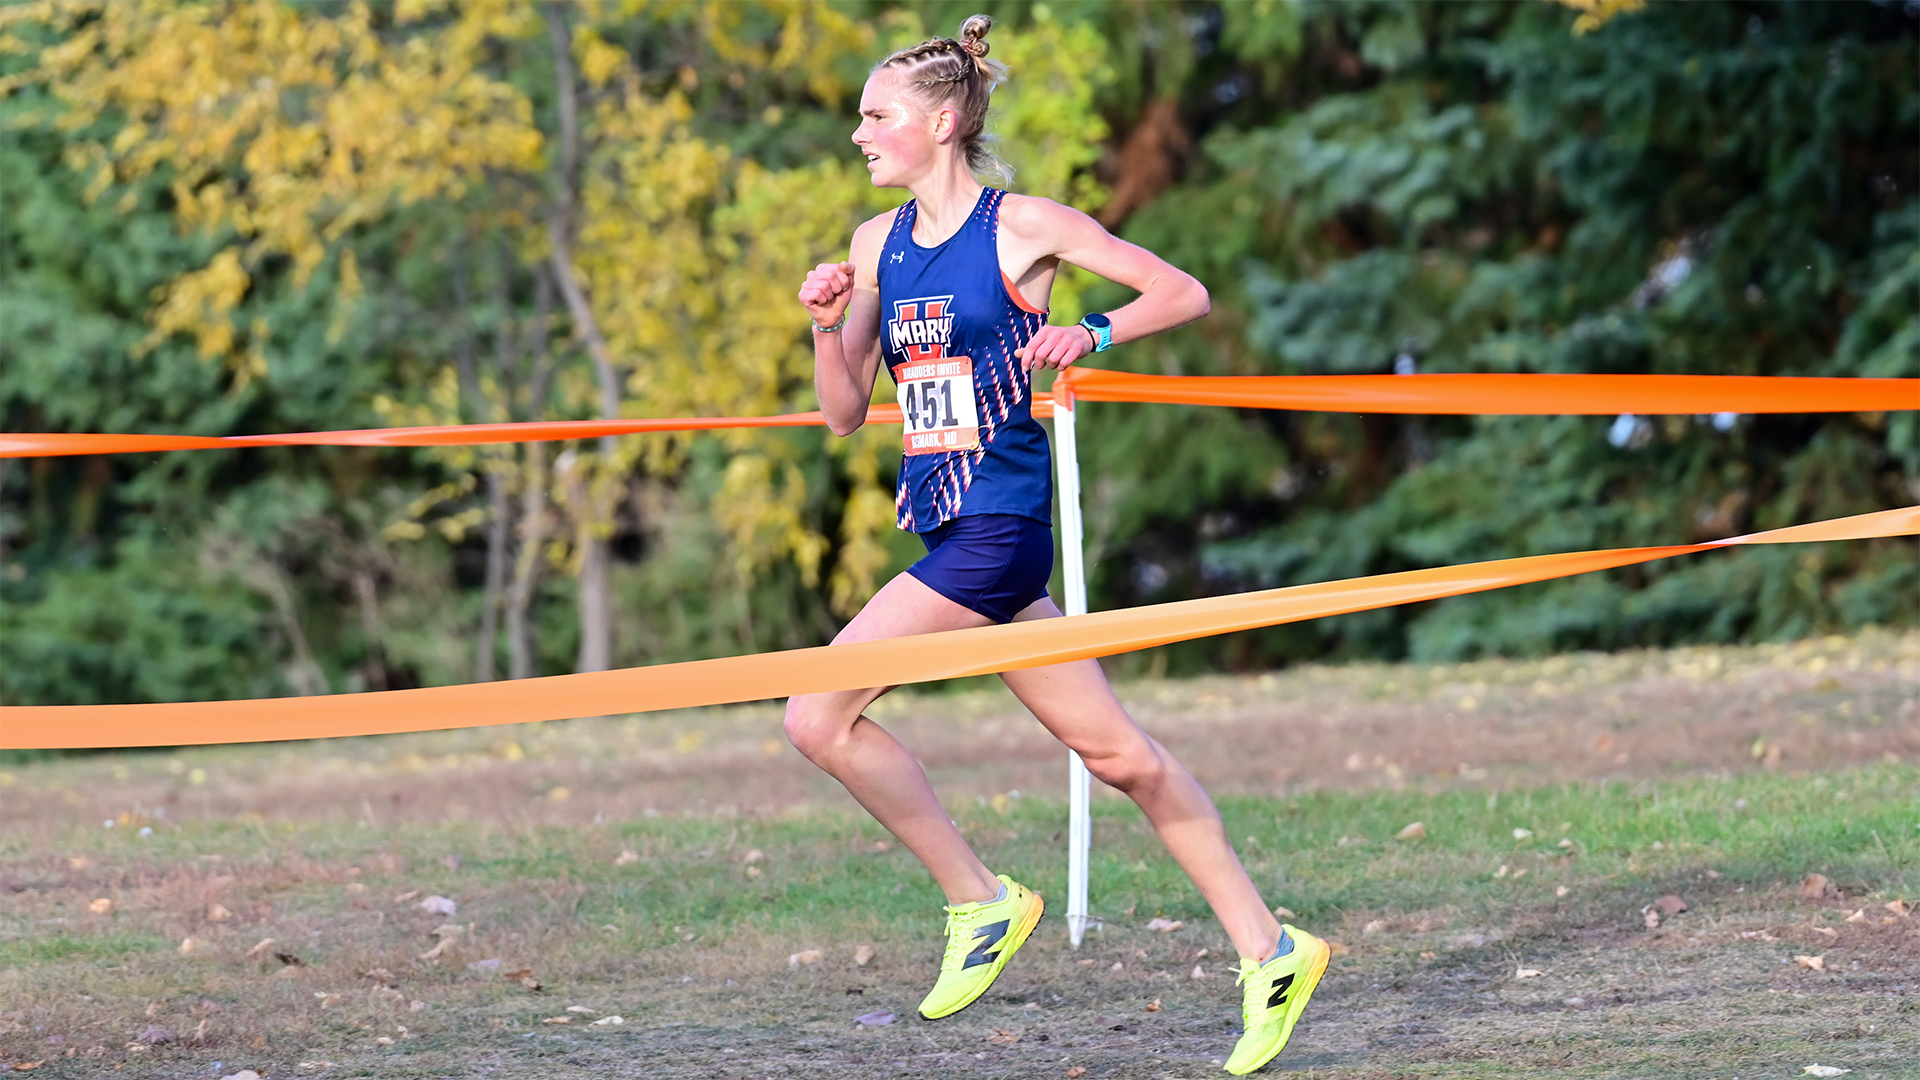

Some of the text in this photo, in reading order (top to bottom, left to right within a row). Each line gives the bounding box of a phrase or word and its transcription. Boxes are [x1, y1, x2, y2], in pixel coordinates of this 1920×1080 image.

[891, 317, 950, 349] MARY
[937, 361, 961, 376] INVITE
[906, 379, 959, 430] 451
[943, 431, 957, 446] ND
